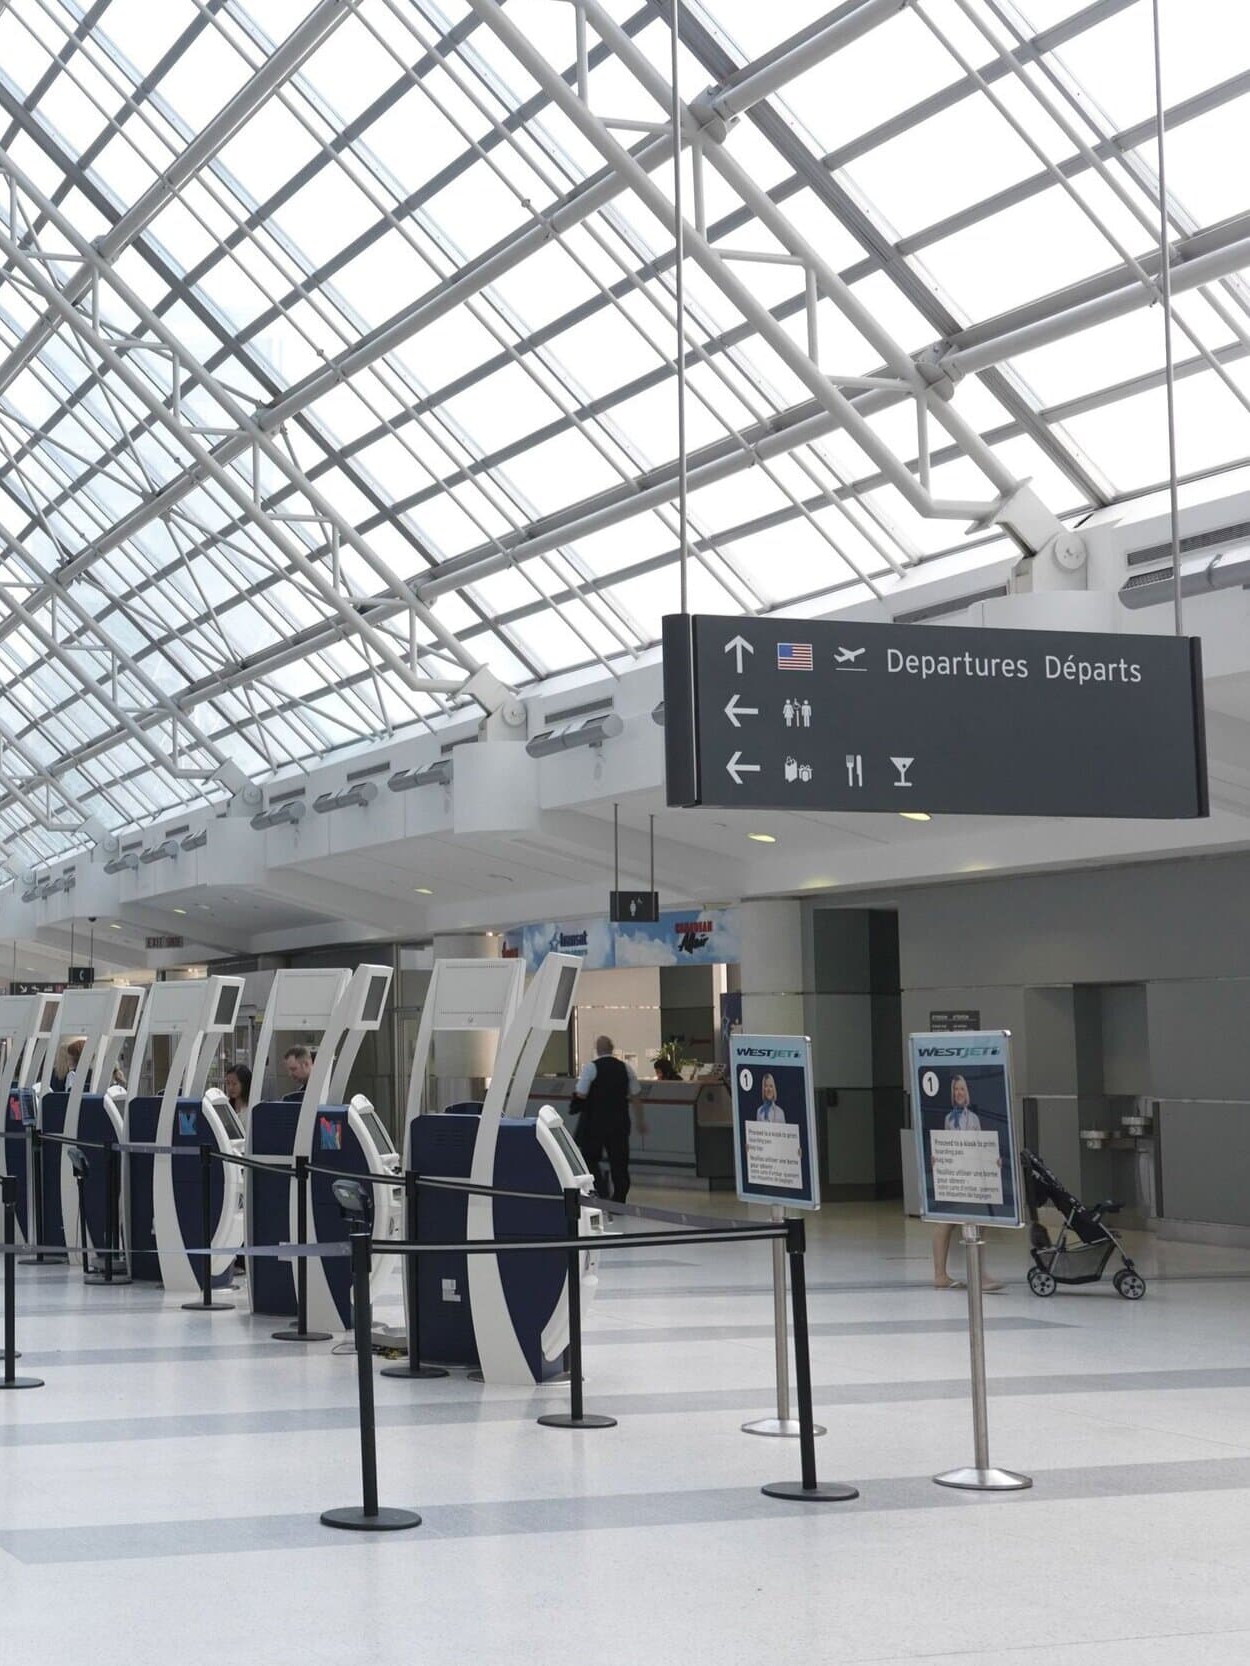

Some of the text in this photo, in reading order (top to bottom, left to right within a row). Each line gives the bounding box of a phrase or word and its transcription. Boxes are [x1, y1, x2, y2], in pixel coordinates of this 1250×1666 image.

[887, 648, 1142, 686] Departures Départs
[736, 1048, 794, 1060] WESTJET
[918, 1046, 991, 1059] WESTJET
[743, 1074, 749, 1088] 1
[927, 1076, 933, 1092] 1
